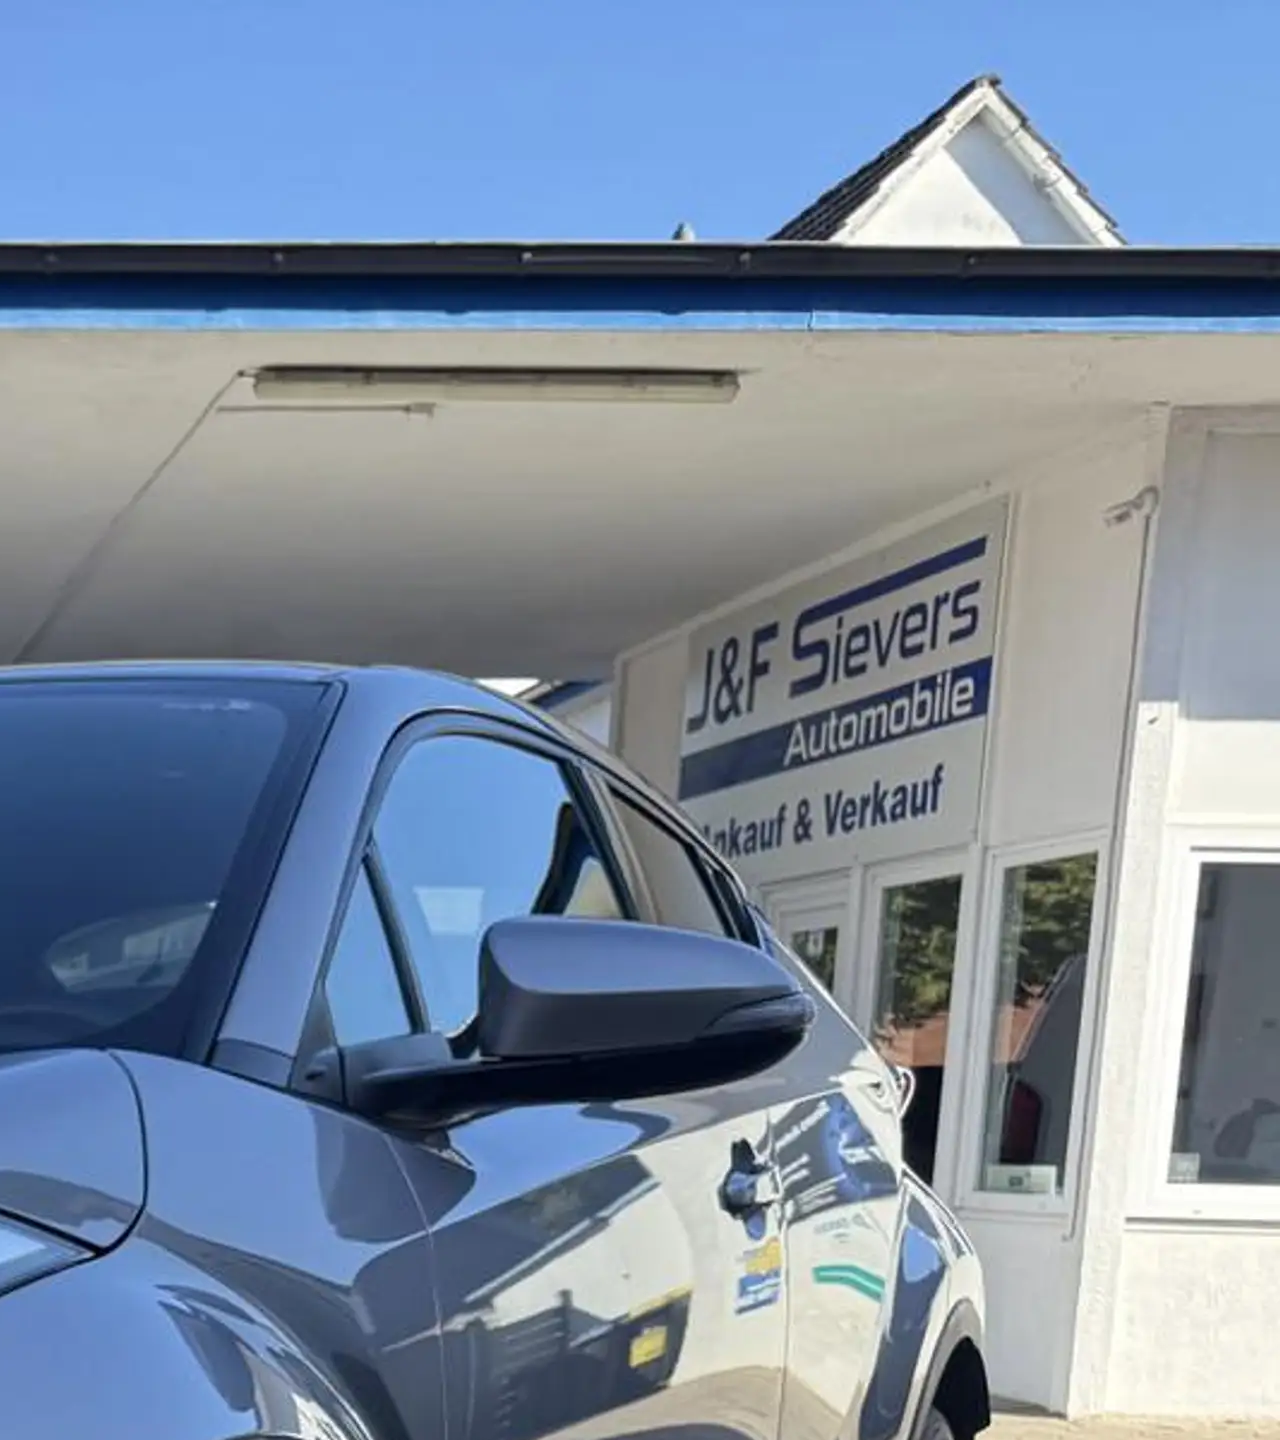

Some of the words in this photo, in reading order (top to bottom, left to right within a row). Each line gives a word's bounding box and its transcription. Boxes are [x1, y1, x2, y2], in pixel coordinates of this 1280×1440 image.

[686, 621, 780, 735] J&F
[789, 579, 982, 699] Sievers
[783, 671, 975, 767] Automobile
[703, 803, 788, 859] nkauf
[793, 798, 813, 844] &
[824, 762, 944, 837] Verkauf
